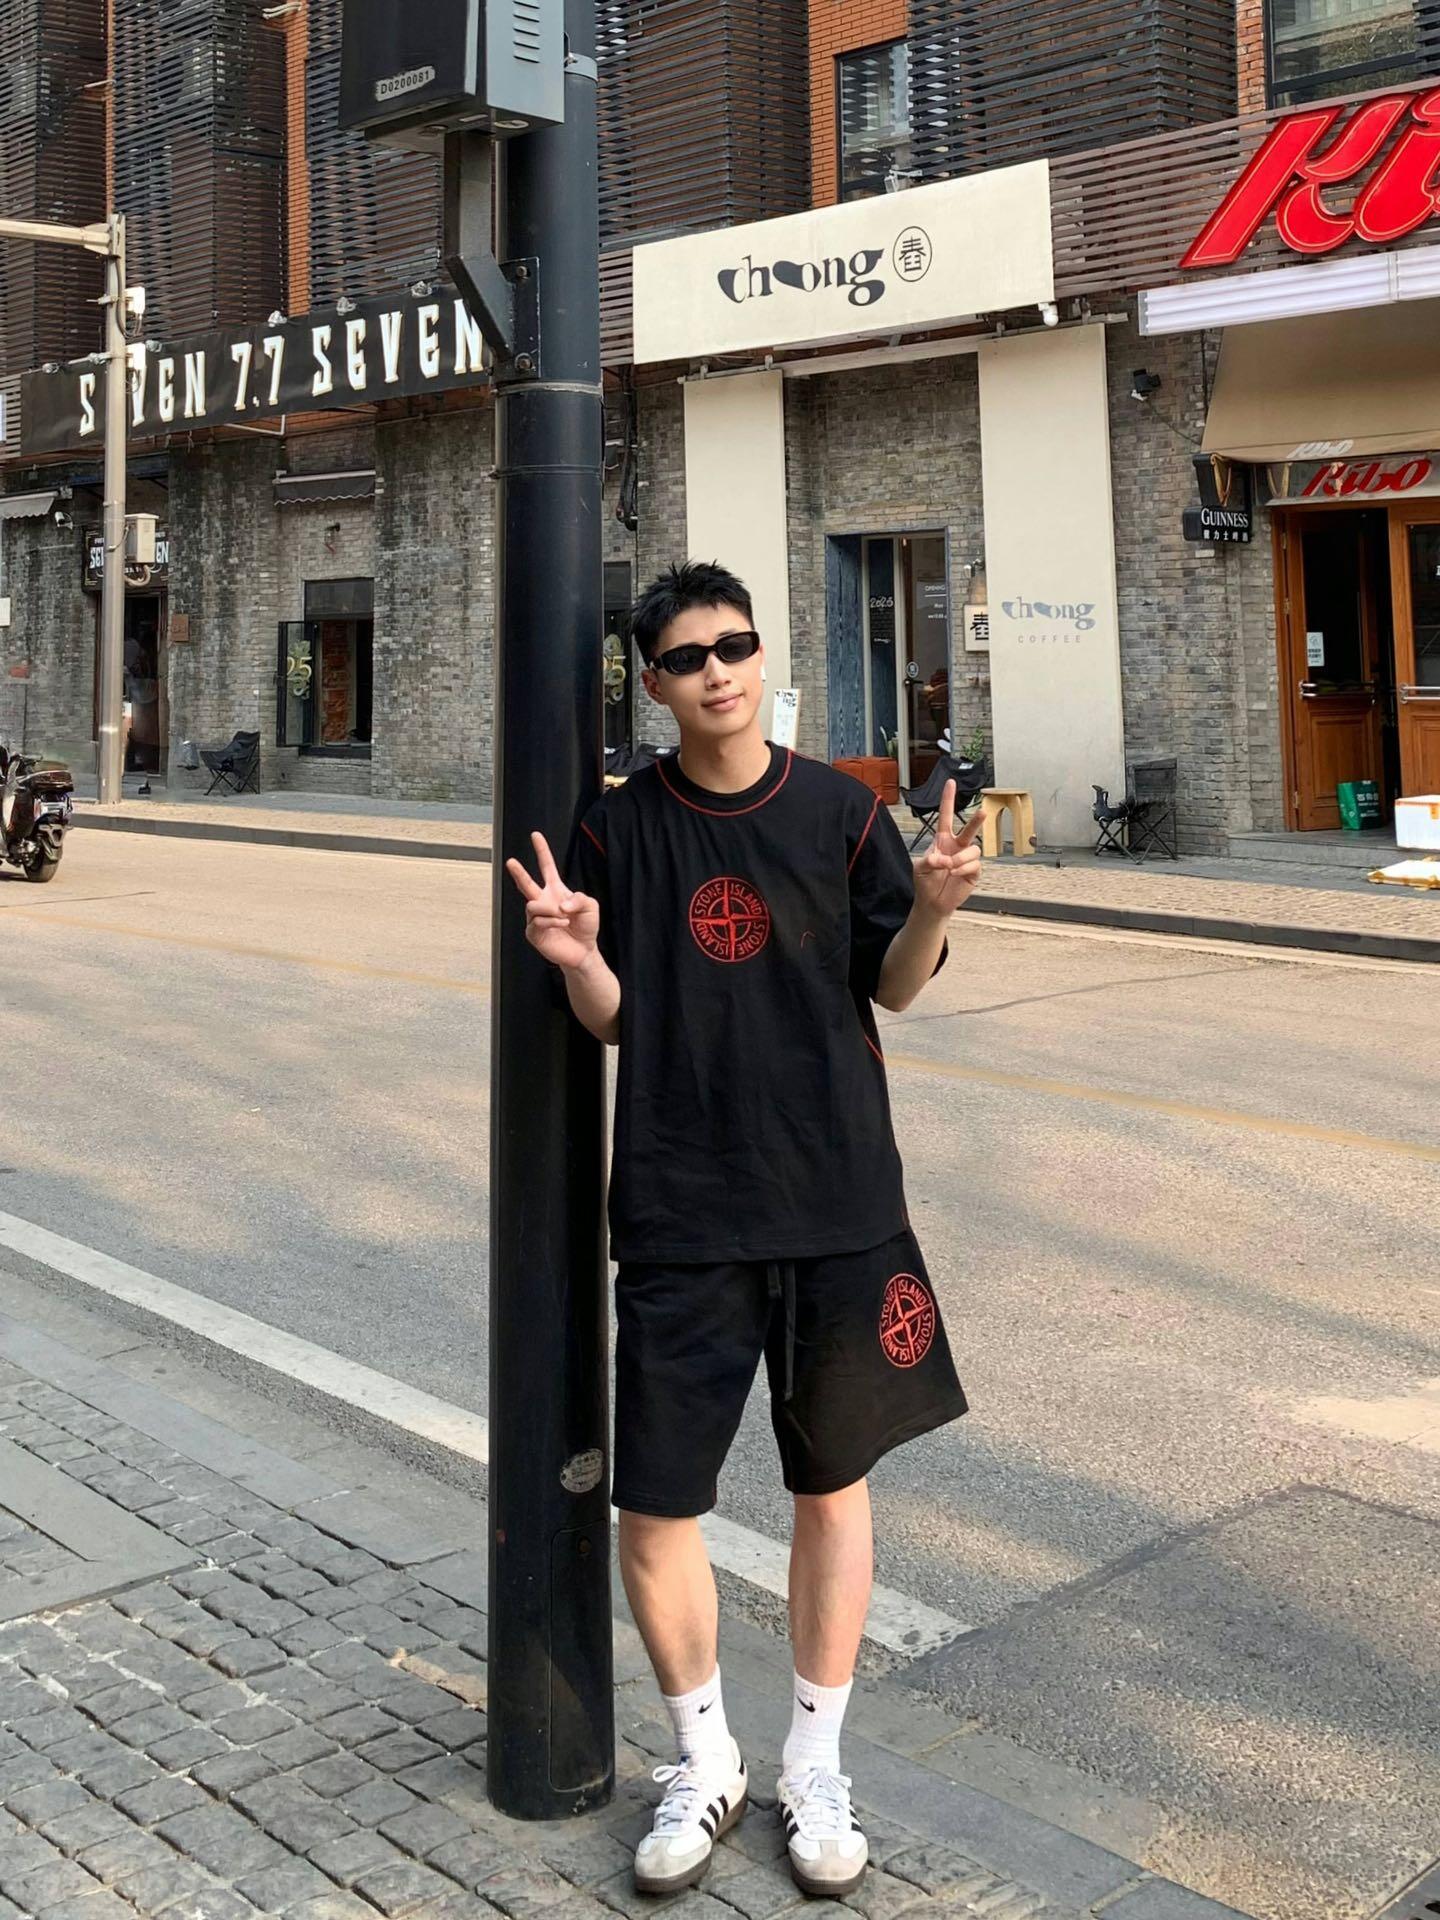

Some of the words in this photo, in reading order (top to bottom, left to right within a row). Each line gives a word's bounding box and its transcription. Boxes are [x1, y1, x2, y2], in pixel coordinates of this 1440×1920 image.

[79, 349, 206, 436] SVEN
[231, 335, 285, 411] 7.7
[311, 299, 484, 396] SEVEN
[1201, 507, 1249, 528] GUINNESS
[1018, 634, 1081, 644] COFFEE
[694, 882, 723, 916] STONE
[730, 882, 763, 916] ISLAND
[696, 921, 730, 956] ISLAND
[735, 921, 766, 956] STONE
[881, 1286, 895, 1328] STONE
[898, 1279, 927, 1306] ISLAND
[914, 1312, 932, 1355] STONE
